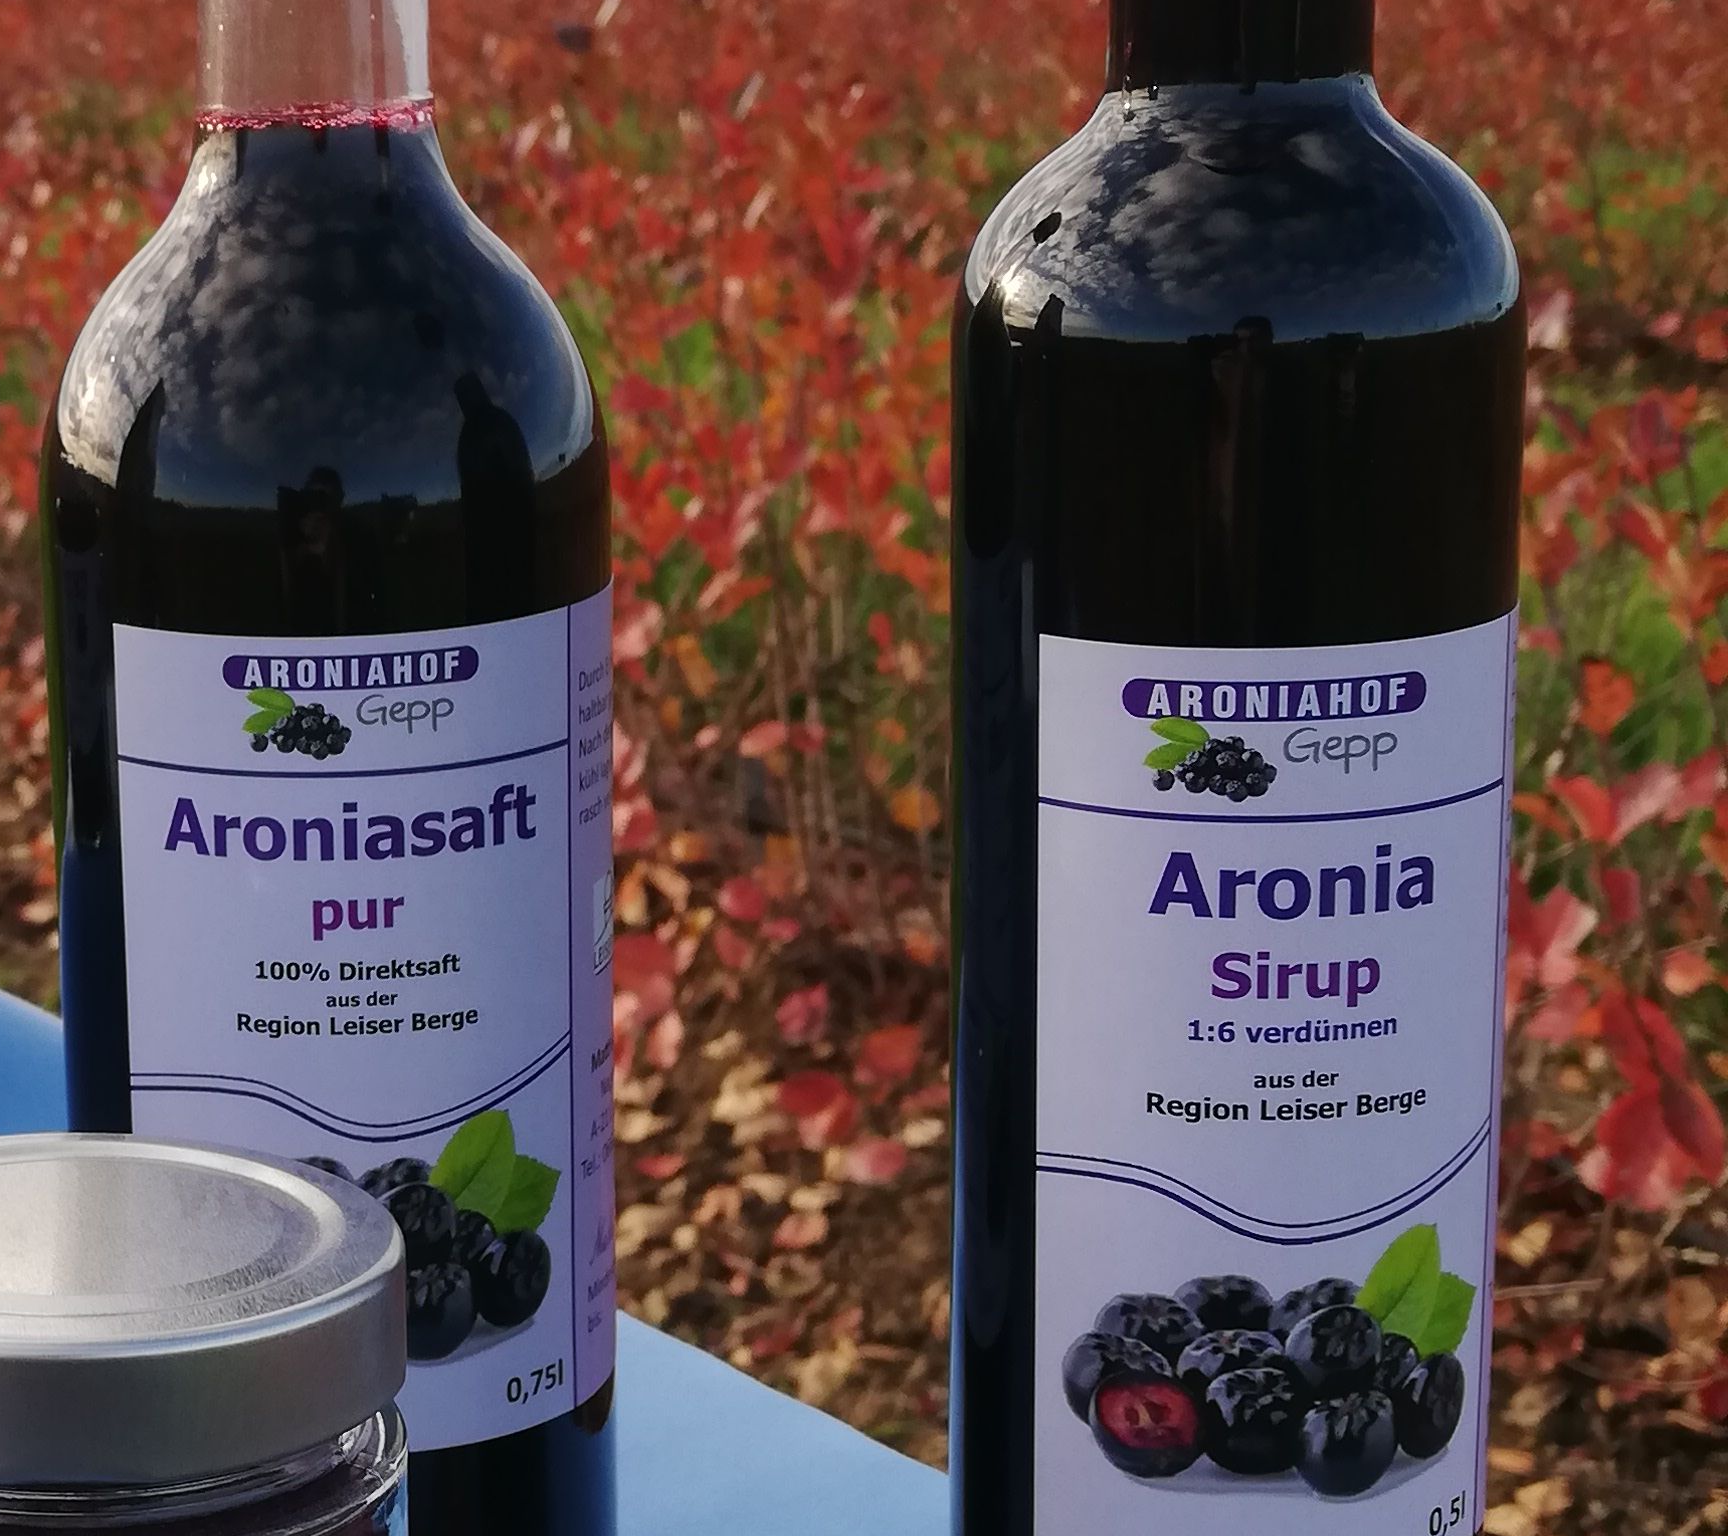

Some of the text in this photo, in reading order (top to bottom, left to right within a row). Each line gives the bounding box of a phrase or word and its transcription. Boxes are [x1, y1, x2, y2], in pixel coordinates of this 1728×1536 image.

[242, 649, 462, 689] ARONIAHOF
[355, 693, 455, 735] Gepp
[1146, 676, 1408, 719] ARONIAHOF
[1282, 725, 1399, 774] Gepp
[164, 783, 537, 863] Aroniasaft
[1148, 843, 1435, 920] Aronia
[312, 895, 406, 942] pur
[254, 953, 462, 982] 100% Direktsaft
[1210, 950, 1381, 1008] Sirup
[325, 989, 399, 1009] aus der
[236, 1007, 480, 1038] Region Leiser Berge
[1187, 1016, 1398, 1045] 1:6 verdünnen
[1253, 1069, 1340, 1089] aus der
[1145, 1085, 1427, 1125] Region Leiser Berge
[505, 1357, 564, 1405] 0,75l
